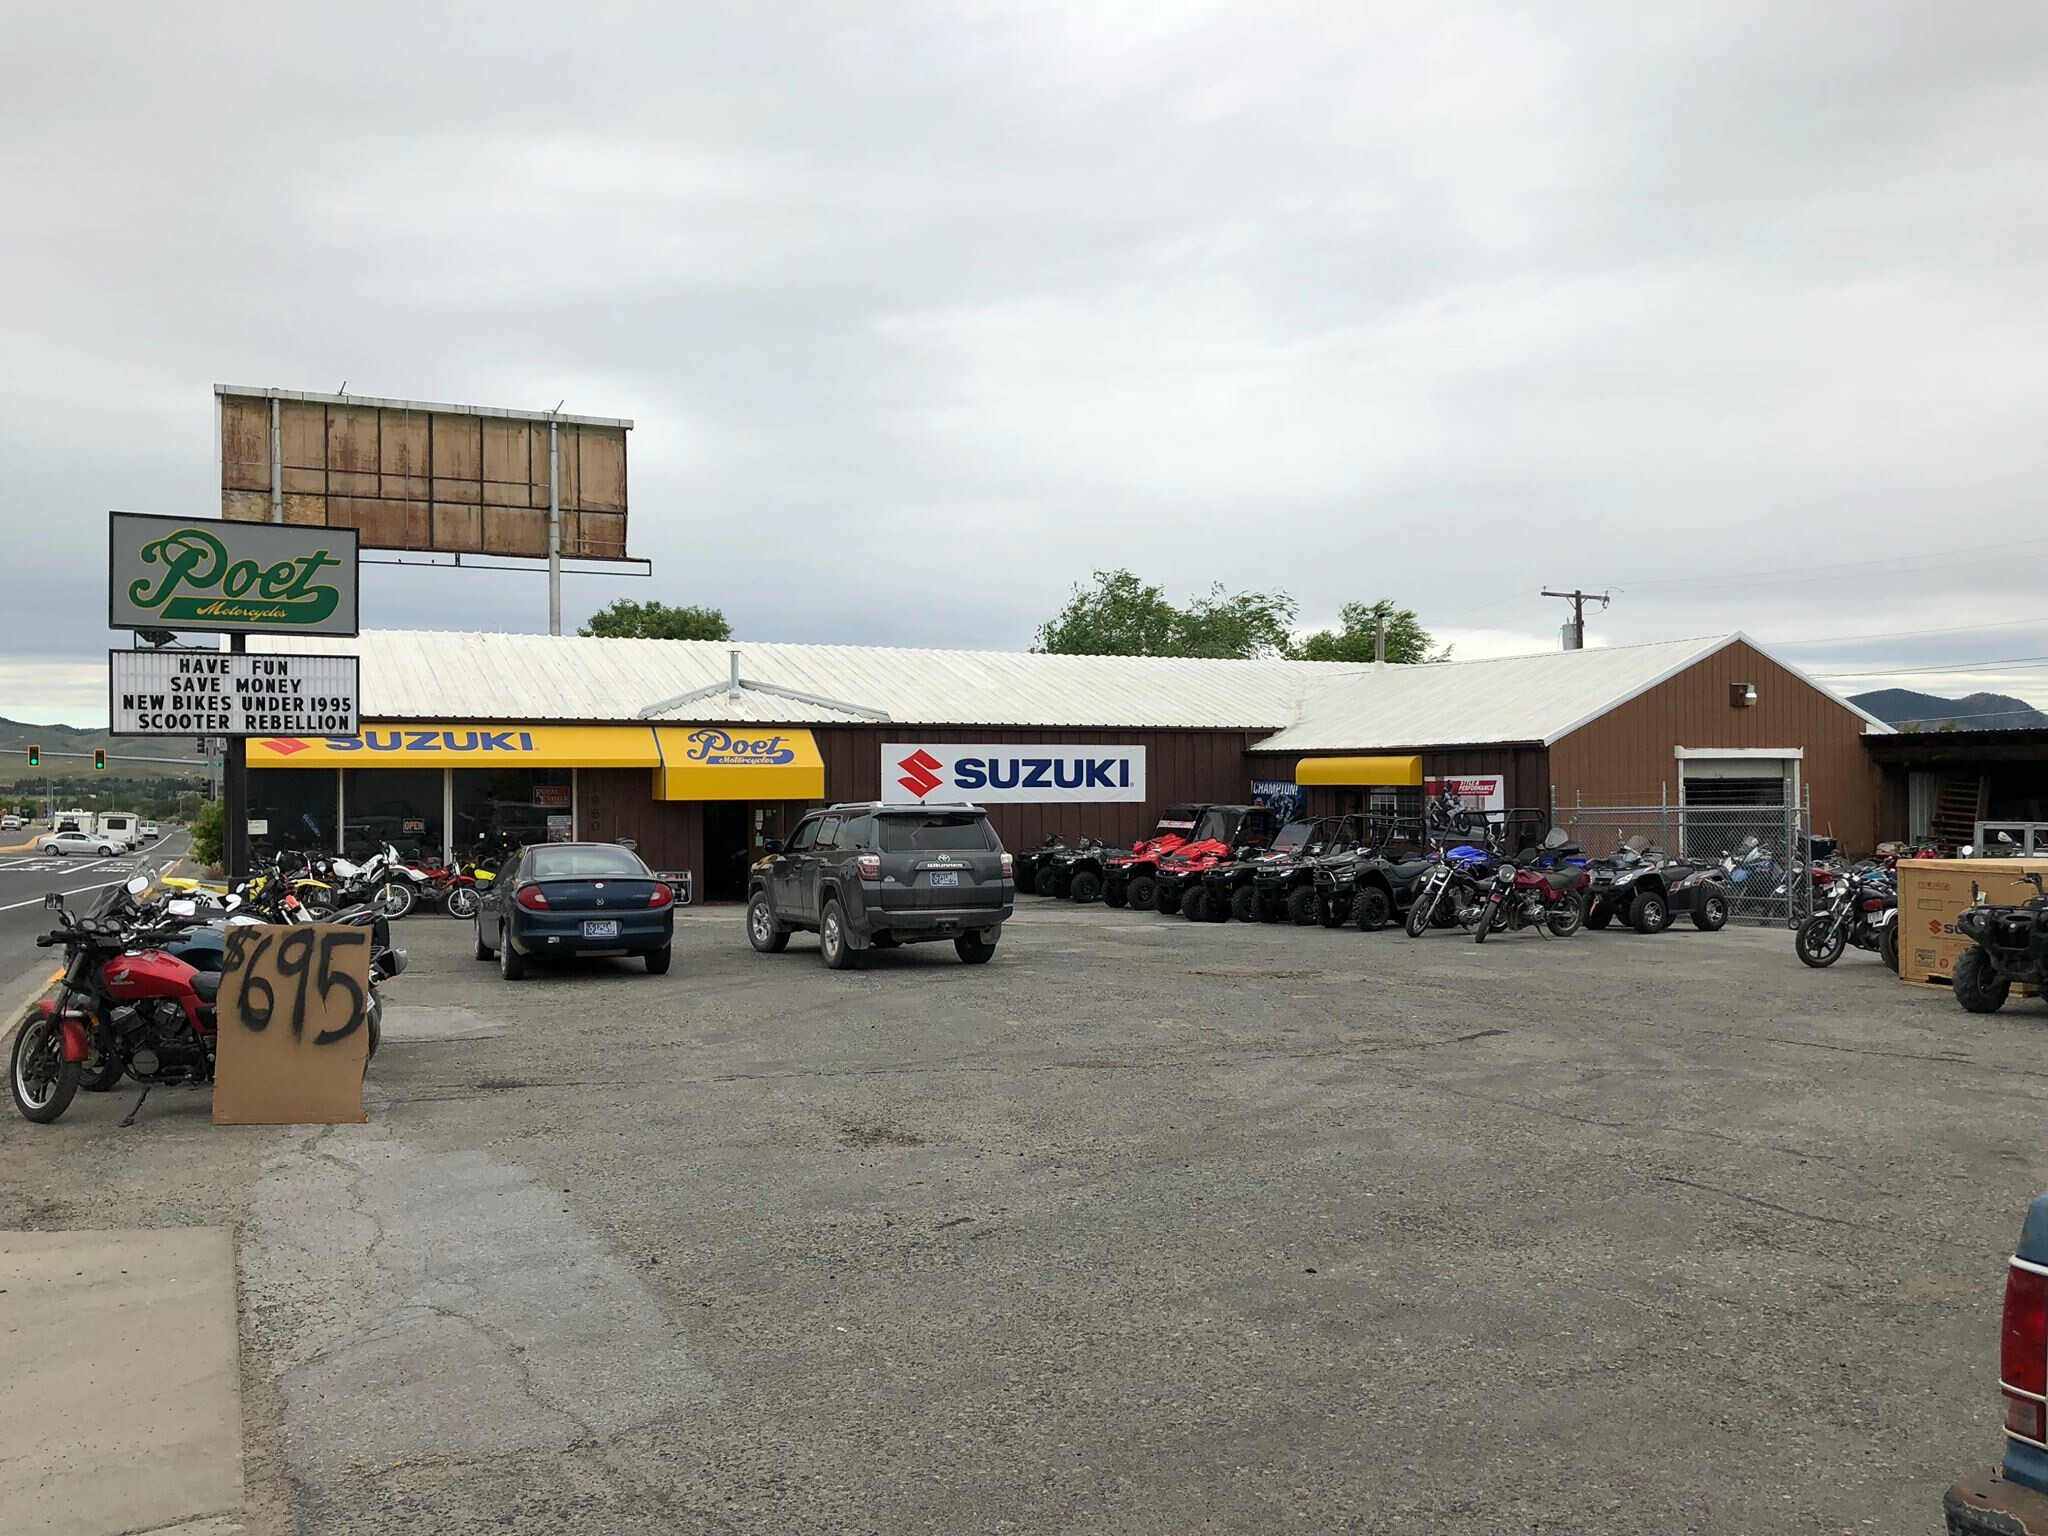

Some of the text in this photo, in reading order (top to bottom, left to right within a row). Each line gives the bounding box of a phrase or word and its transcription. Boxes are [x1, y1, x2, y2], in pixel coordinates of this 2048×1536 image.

[129, 529, 341, 617] Poet
[196, 601, 287, 621] Motorcycles
[179, 659, 289, 676] HAVE FUN
[171, 677, 302, 694] SAVE MONEY
[123, 694, 352, 712] NEW BIKES UNDER 1995
[139, 713, 349, 731] SCOOTER REBELLION
[325, 731, 534, 751] SUZUKI
[687, 729, 794, 763] Poet
[954, 758, 1130, 789] SUZUKI
[404, 821, 423, 830] OPEN
[217, 925, 366, 1046] $695
